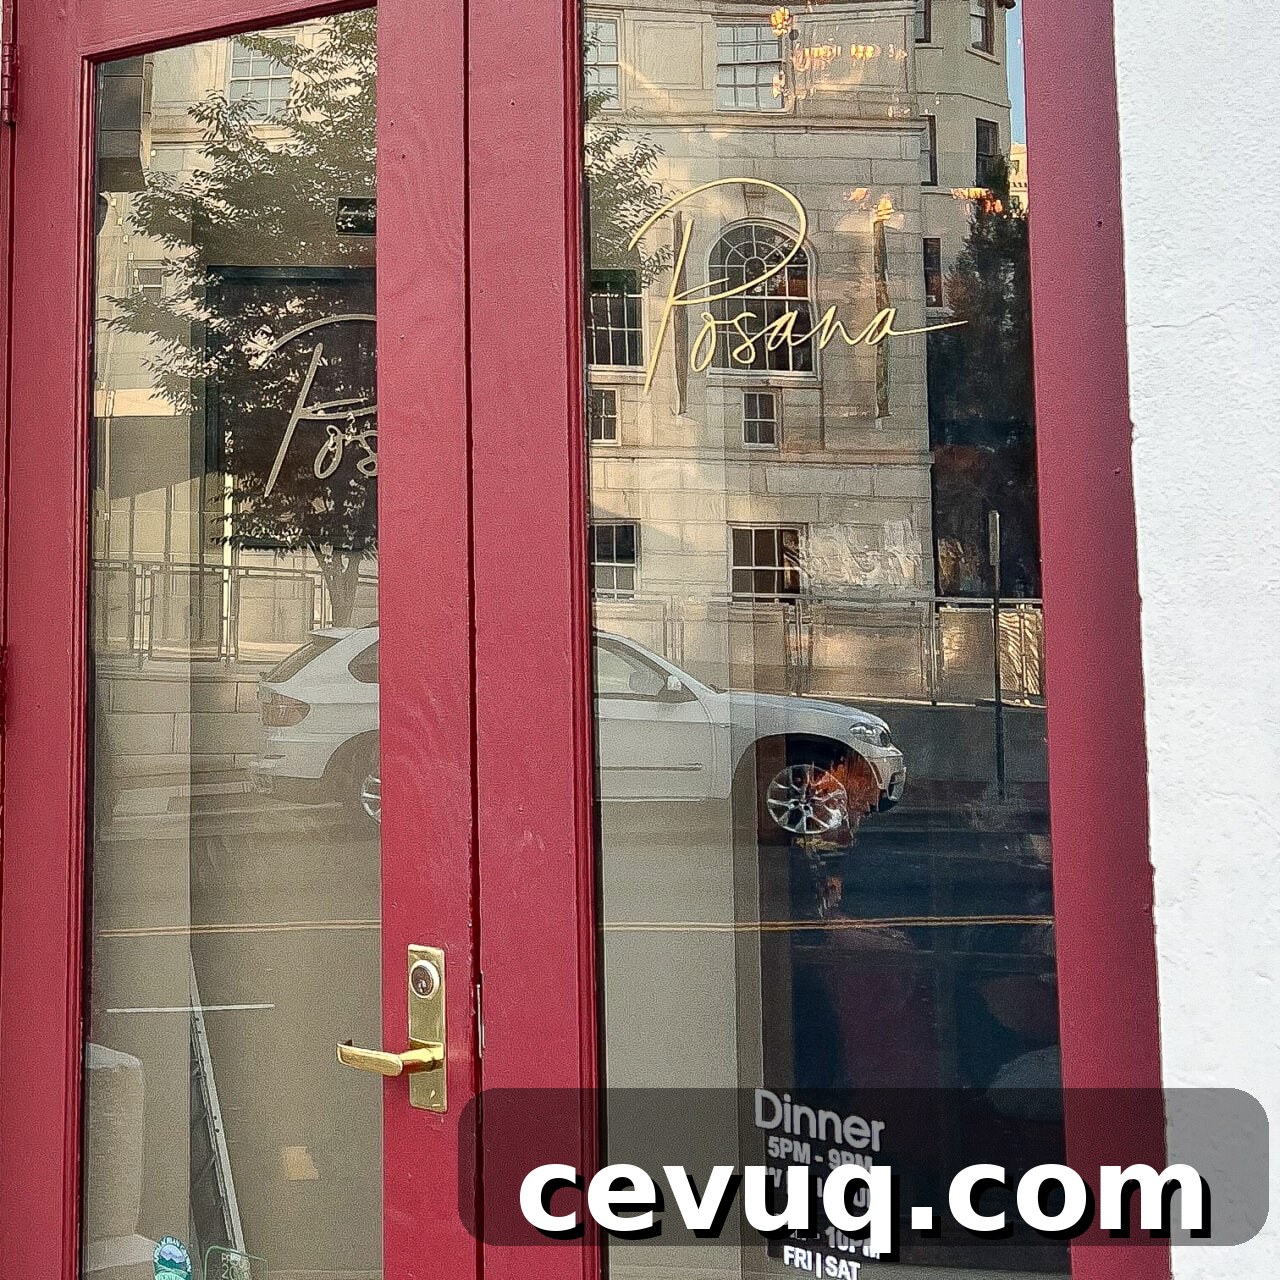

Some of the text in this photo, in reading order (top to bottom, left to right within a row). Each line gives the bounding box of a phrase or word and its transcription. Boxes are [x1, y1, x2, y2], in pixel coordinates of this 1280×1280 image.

[628, 177, 969, 396] Posana
[754, 1088, 886, 1152] Dinner
[767, 1136, 811, 1165] 5PM
[783, 1245, 813, 1272] FRI
[825, 1255, 861, 1280] SAT
